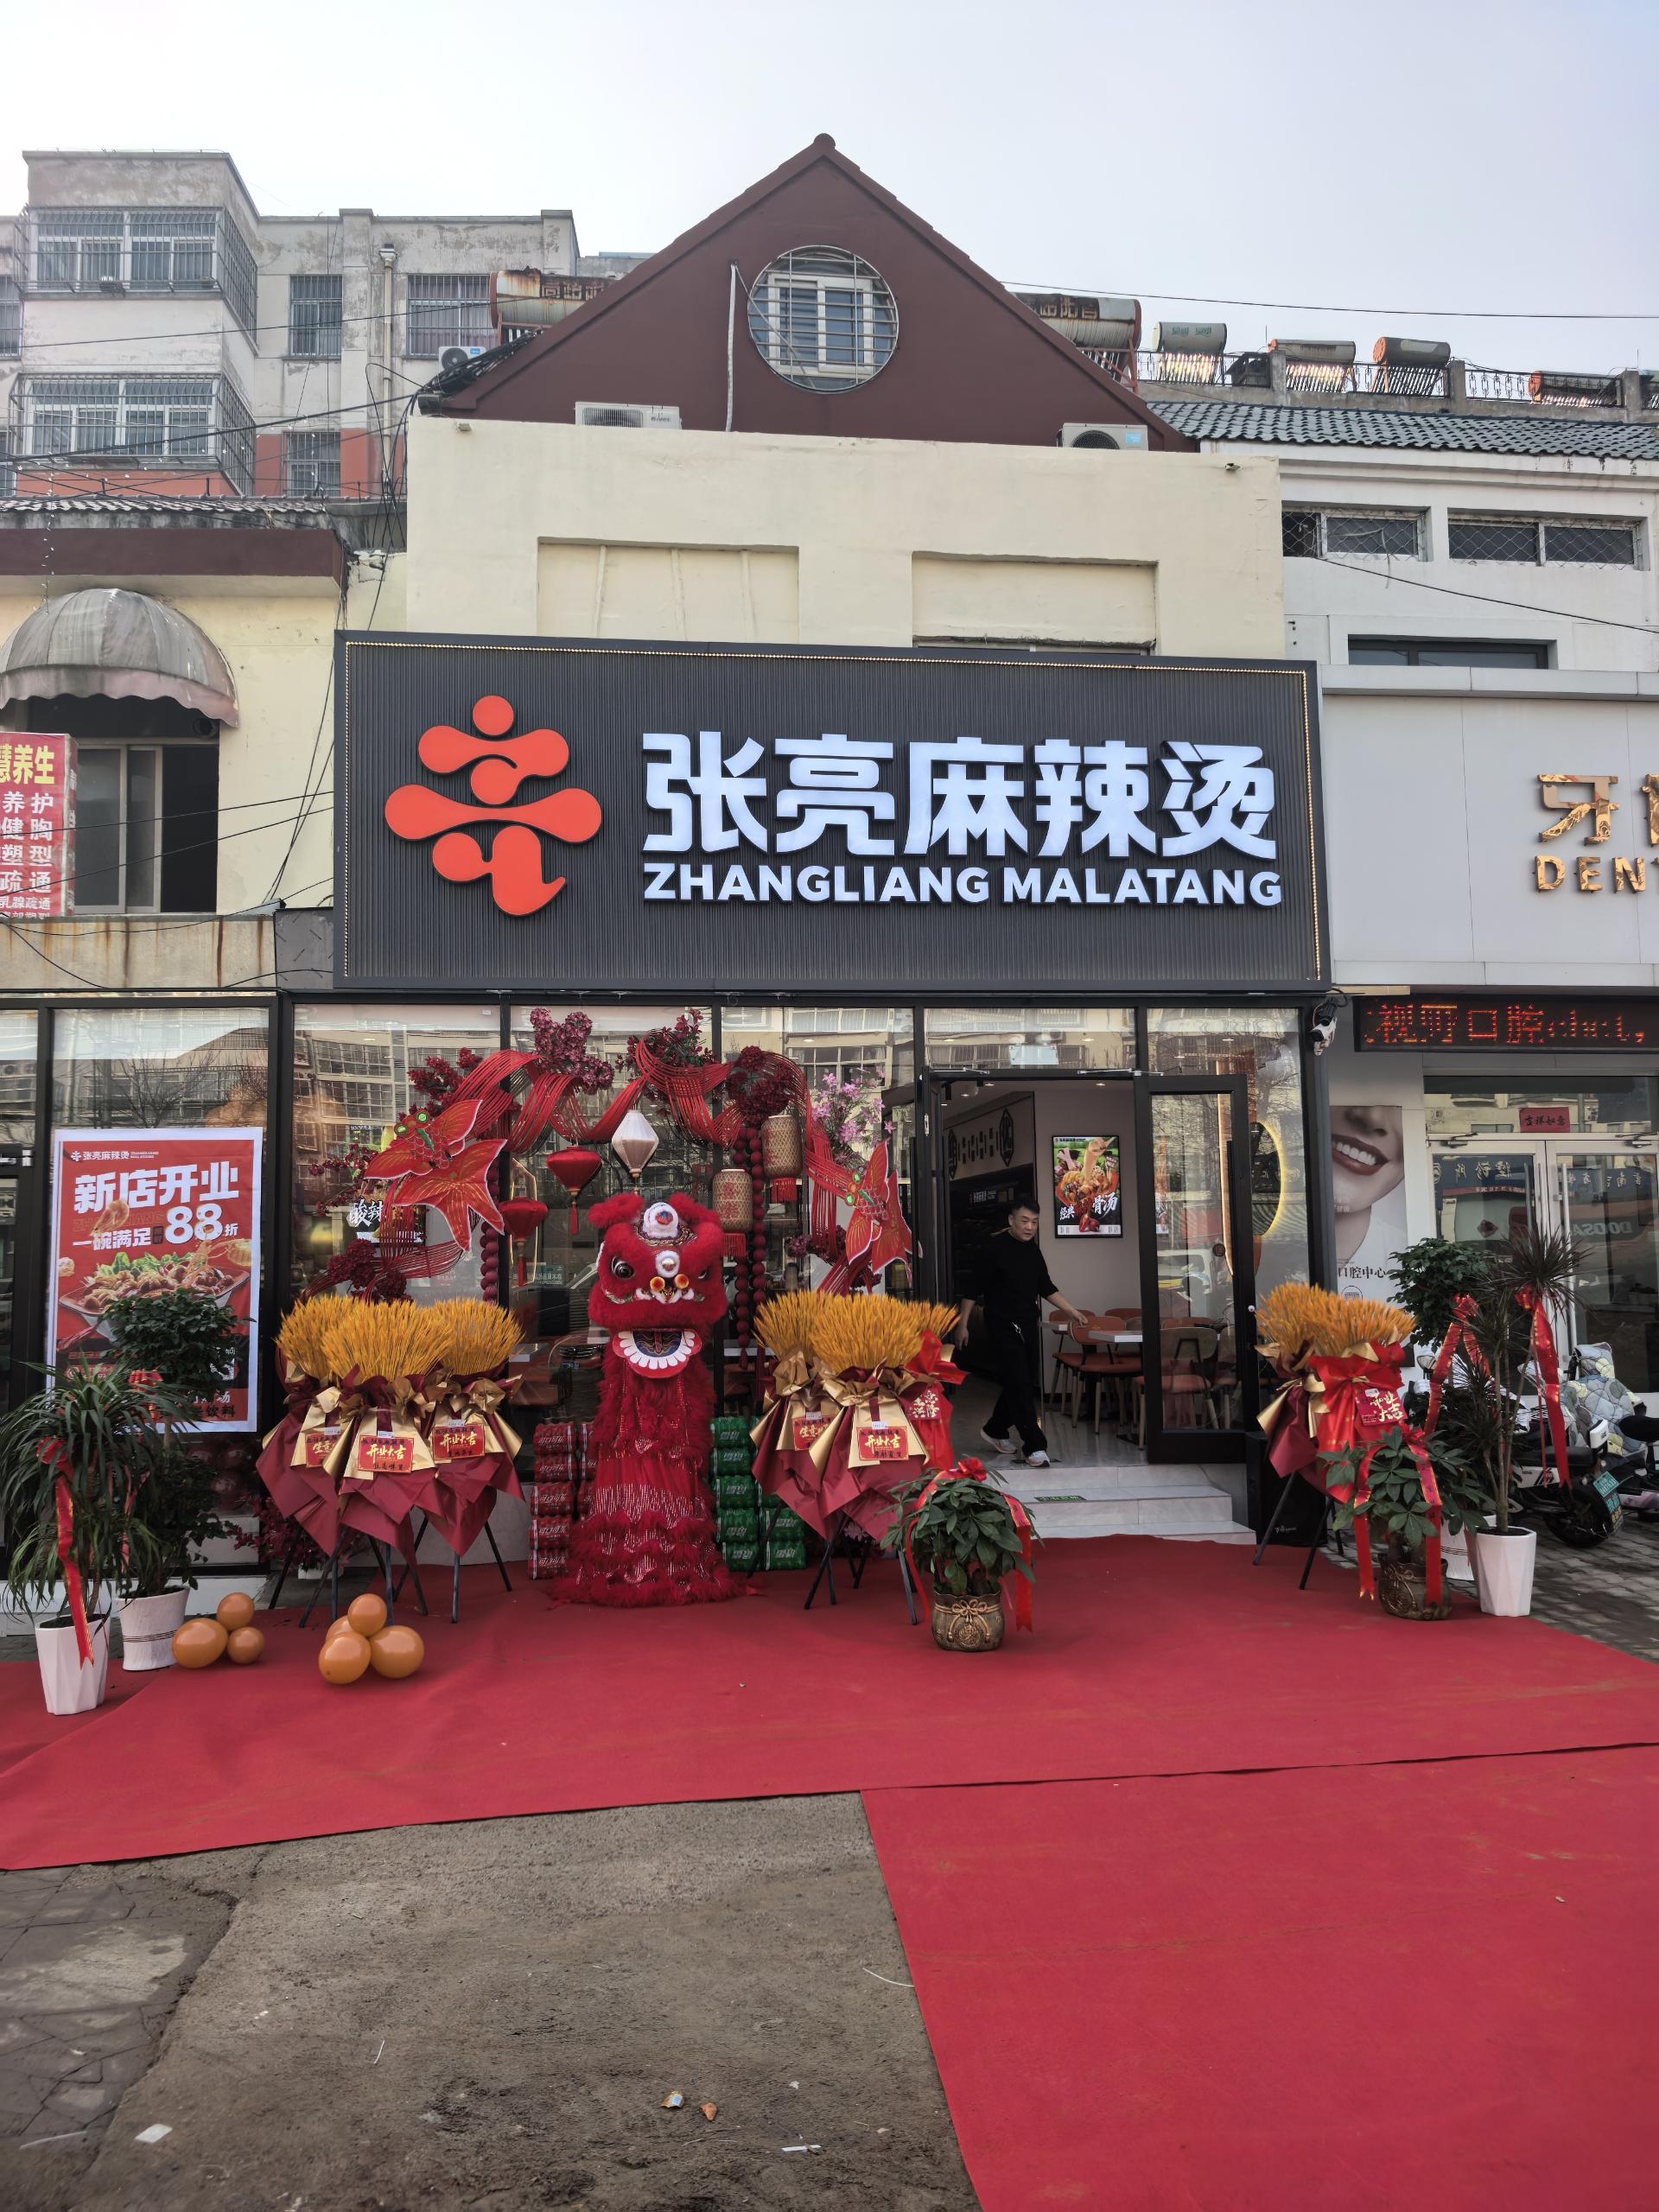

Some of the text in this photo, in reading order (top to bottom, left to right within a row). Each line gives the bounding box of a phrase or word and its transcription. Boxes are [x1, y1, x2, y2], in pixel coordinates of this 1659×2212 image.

[642, 730, 1277, 860] 张亮麻辣烫
[644, 864, 1282, 907] ZHANGLIANG MALATANG
[1534, 855, 1659, 893] DEN
[73, 1161, 239, 1213] 新店开业
[73, 1227, 152, 1250] 一碗满足
[366, 1443, 406, 1464] 开业大吉
[440, 1431, 477, 1452] 开业大吉
[865, 1433, 900, 1454] 开业大吉
